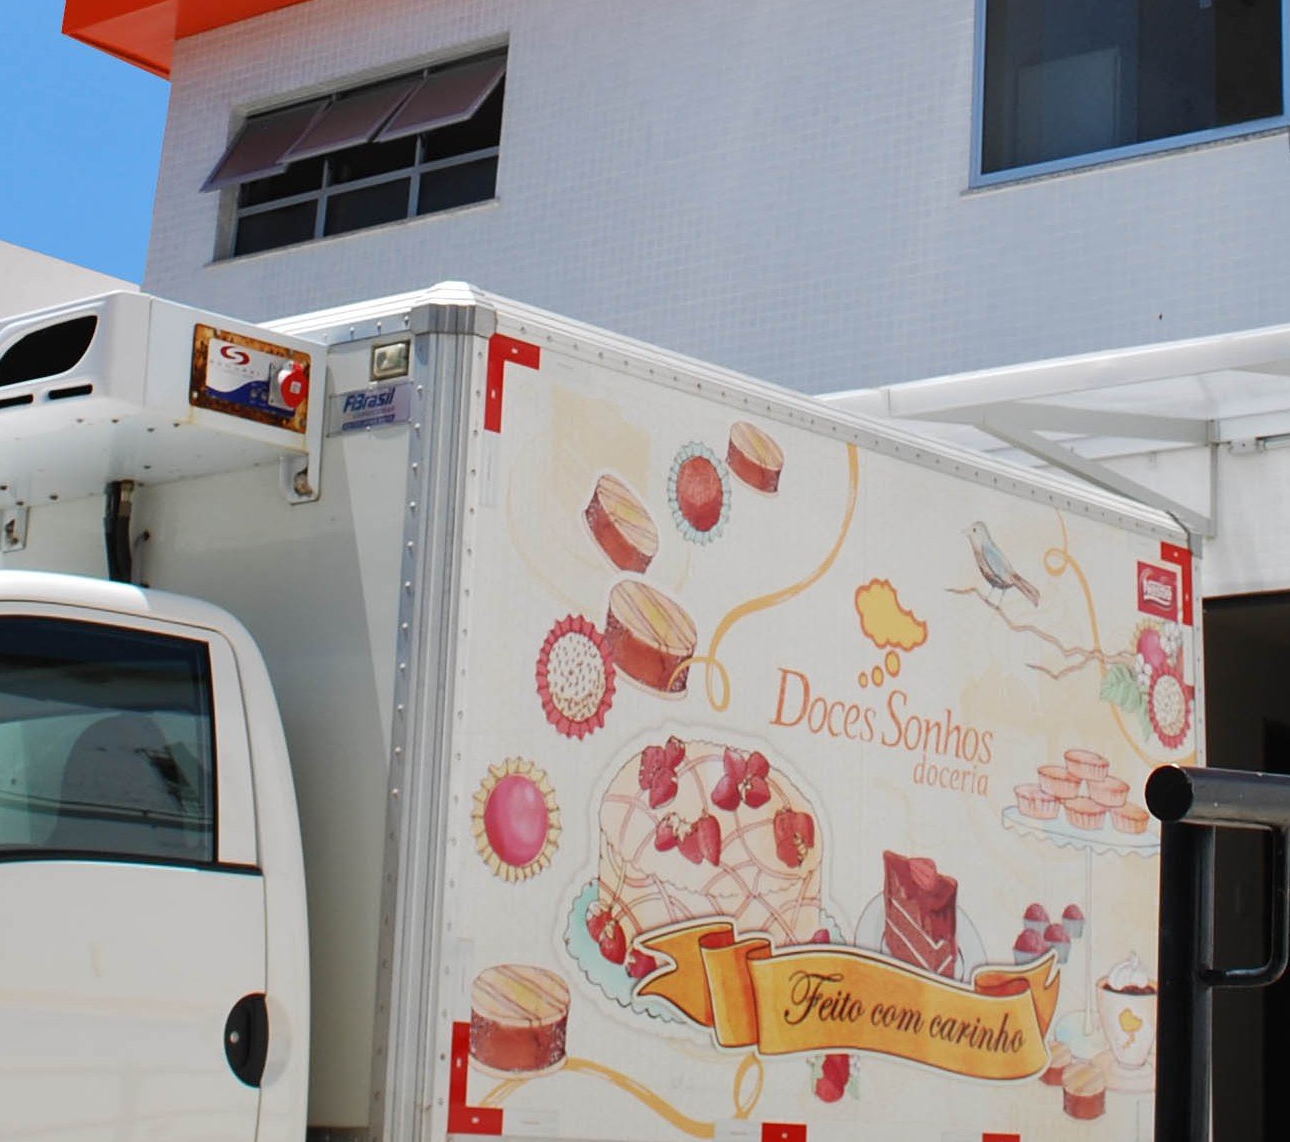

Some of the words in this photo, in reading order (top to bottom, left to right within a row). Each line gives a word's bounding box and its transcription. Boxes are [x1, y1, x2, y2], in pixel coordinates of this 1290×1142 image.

[769, 666, 877, 742] Doces
[881, 689, 994, 765] Sonhos
[912, 754, 990, 796] doceria
[784, 970, 864, 1026] Feito
[870, 1001, 924, 1035] com
[928, 1012, 1027, 1055] carinho
